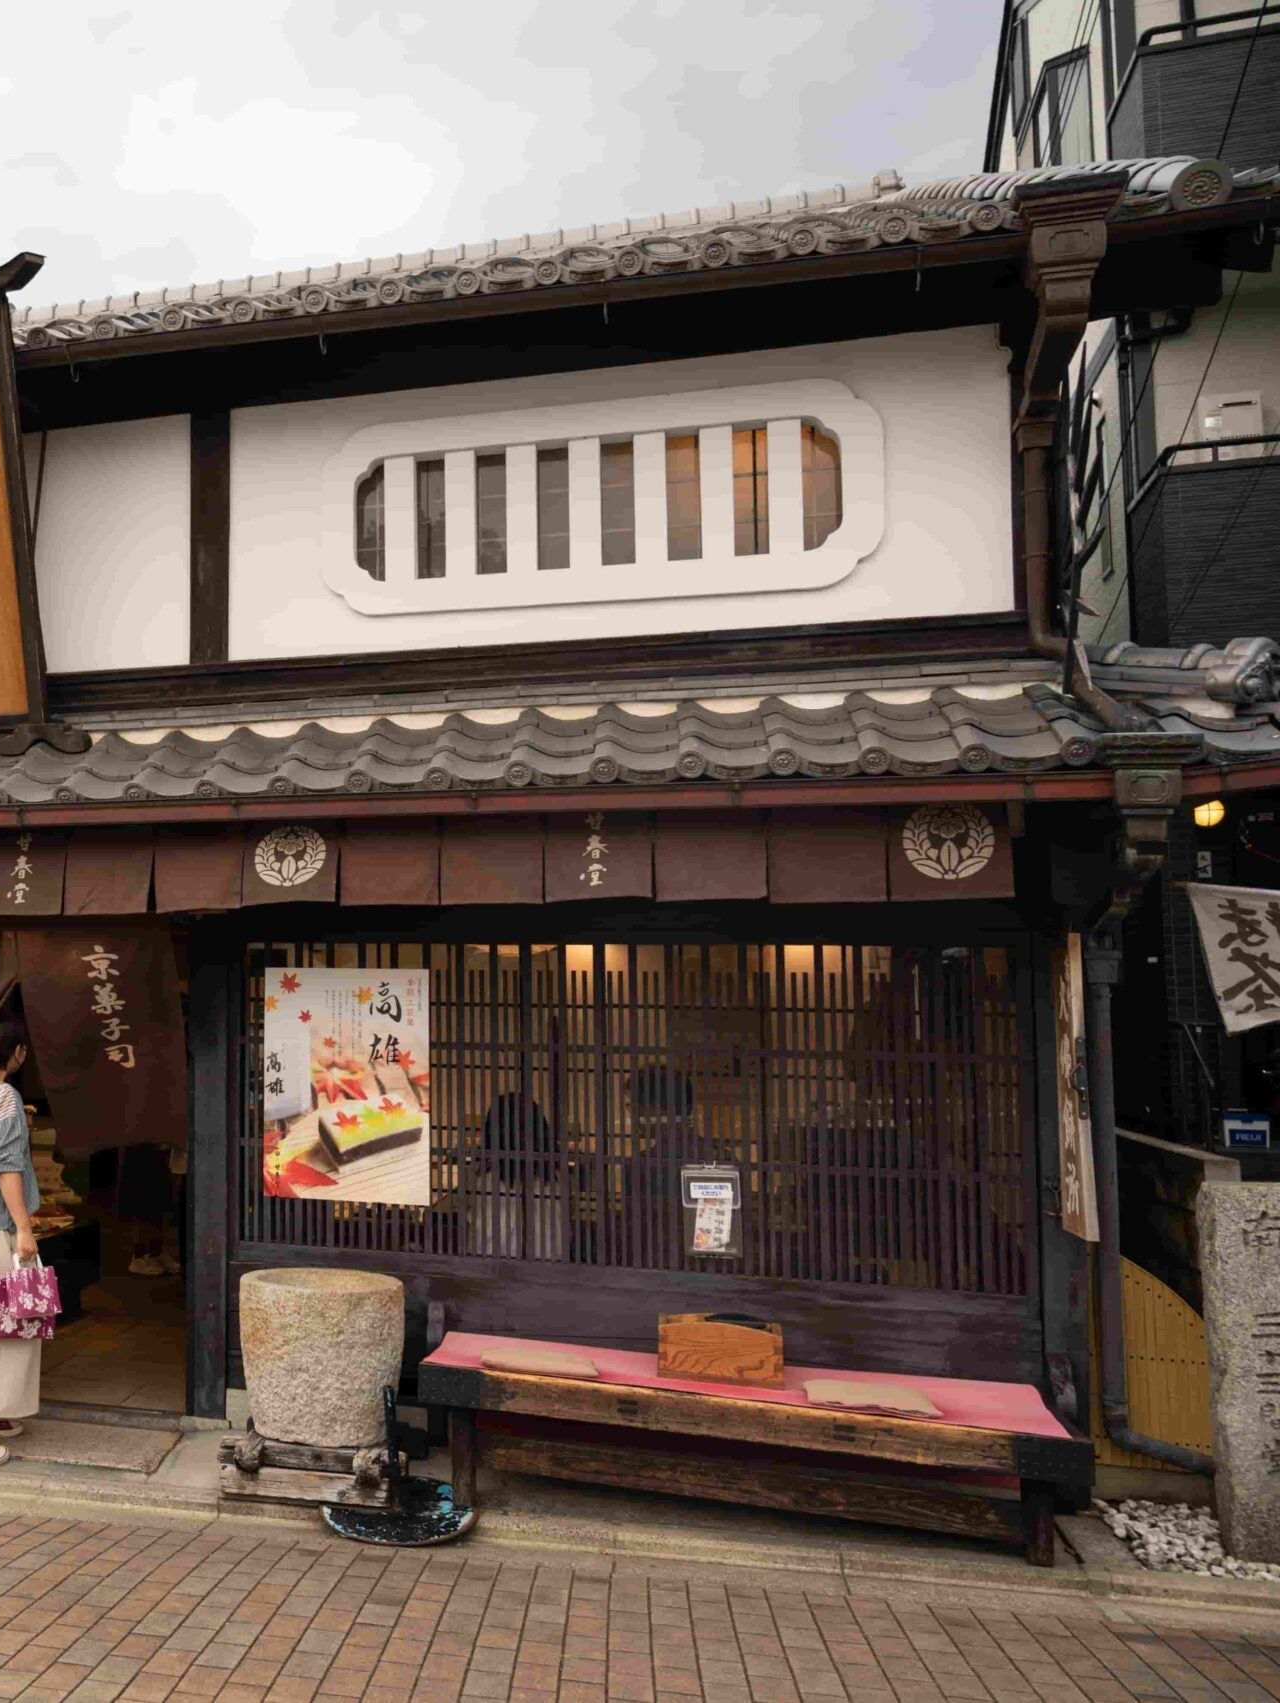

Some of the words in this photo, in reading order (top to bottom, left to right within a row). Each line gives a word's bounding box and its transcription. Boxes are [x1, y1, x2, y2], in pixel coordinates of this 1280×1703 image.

[6, 835, 33, 905] 甘春堂
[580, 811, 609, 886] 甘春堂
[81, 945, 135, 1069] 京菓子司
[368, 981, 402, 1065] 高雄
